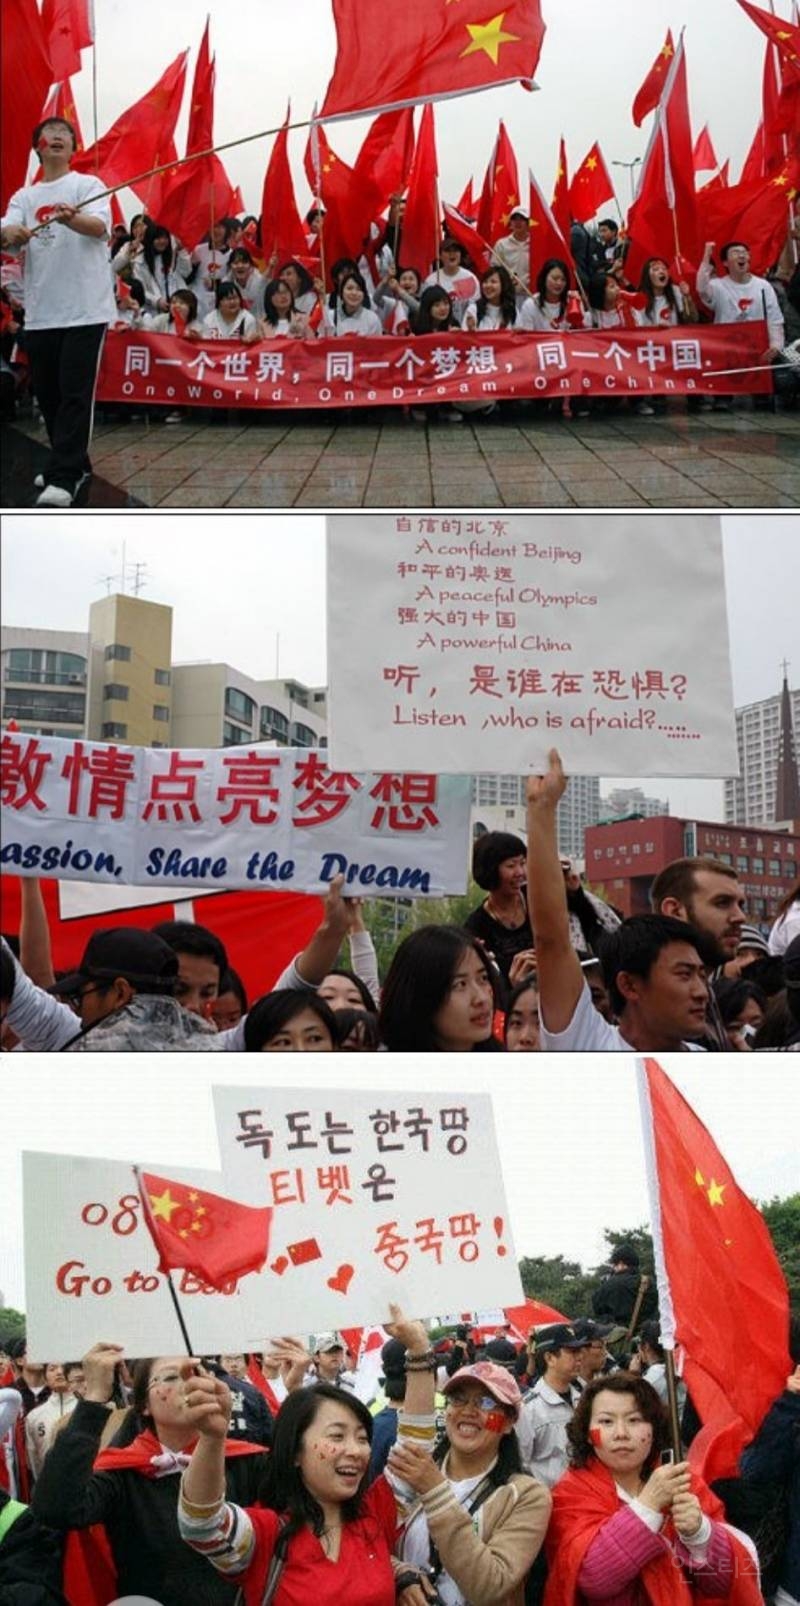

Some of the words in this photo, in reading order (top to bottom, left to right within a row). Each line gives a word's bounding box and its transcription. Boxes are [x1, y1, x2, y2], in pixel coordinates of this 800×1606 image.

[396, 517, 509, 537] 自信的北京
[415, 538, 433, 554] A
[437, 540, 516, 560] confident
[523, 543, 581, 564] Beijing
[416, 585, 434, 601] A
[438, 588, 514, 607] peaceful
[518, 588, 598, 608] Olympics
[397, 607, 516, 628] 强大的中国
[417, 632, 436, 649] A
[441, 634, 516, 654] powerful
[520, 635, 572, 652] China
[393, 705, 466, 726] Listen
[546, 709, 562, 728] is
[146, 846, 228, 879] Share
[245, 851, 295, 881] the
[318, 852, 430, 893] Dream
[236, 1109, 354, 1159] 독도는
[369, 1107, 470, 1155] 한국땅
[270, 1163, 396, 1205] 티벳은
[374, 1213, 507, 1273] 중국땅!
[56, 1261, 112, 1297] Go
[123, 1270, 159, 1292] to
